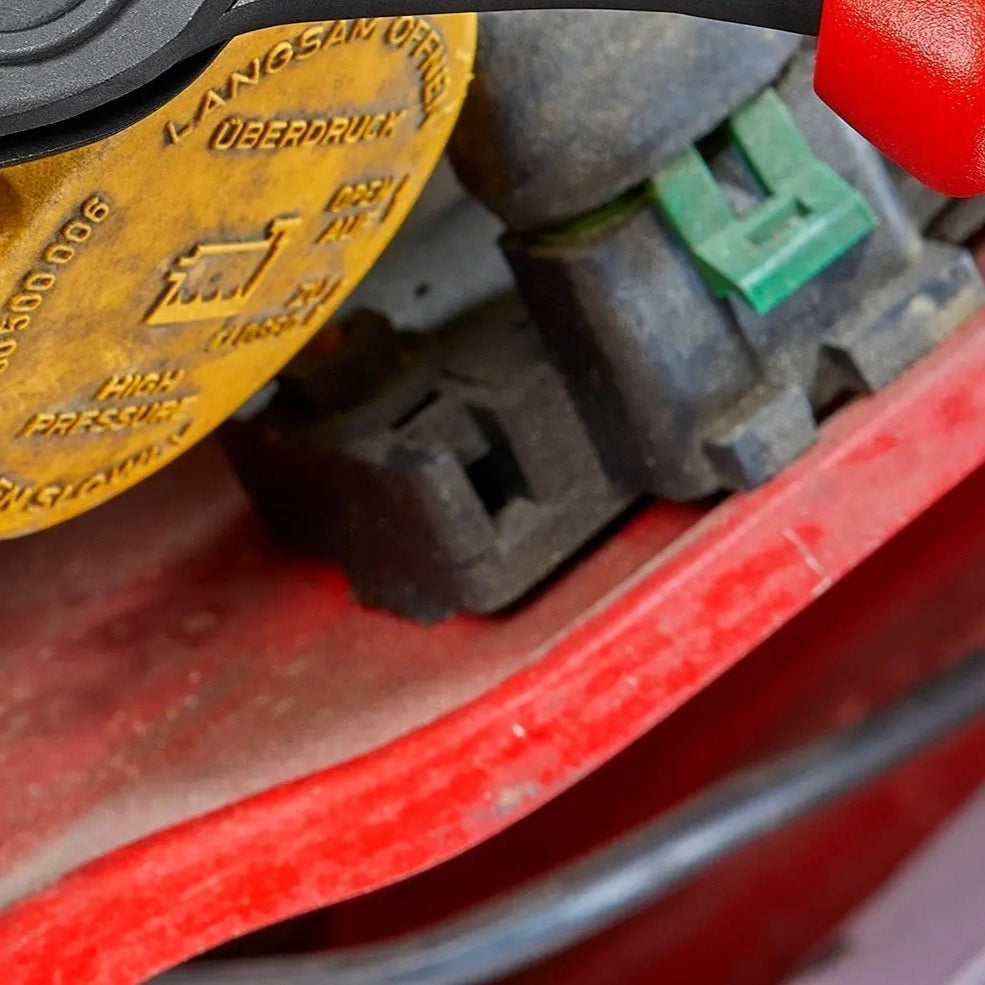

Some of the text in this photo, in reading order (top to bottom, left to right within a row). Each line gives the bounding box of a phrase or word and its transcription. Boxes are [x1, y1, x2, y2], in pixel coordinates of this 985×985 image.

[166, 18, 378, 145] LANGSAM
[210, 109, 408, 150] ÜBERDRUCK
[92, 369, 186, 403] HIGH
[16, 394, 199, 439] PRESSURE
